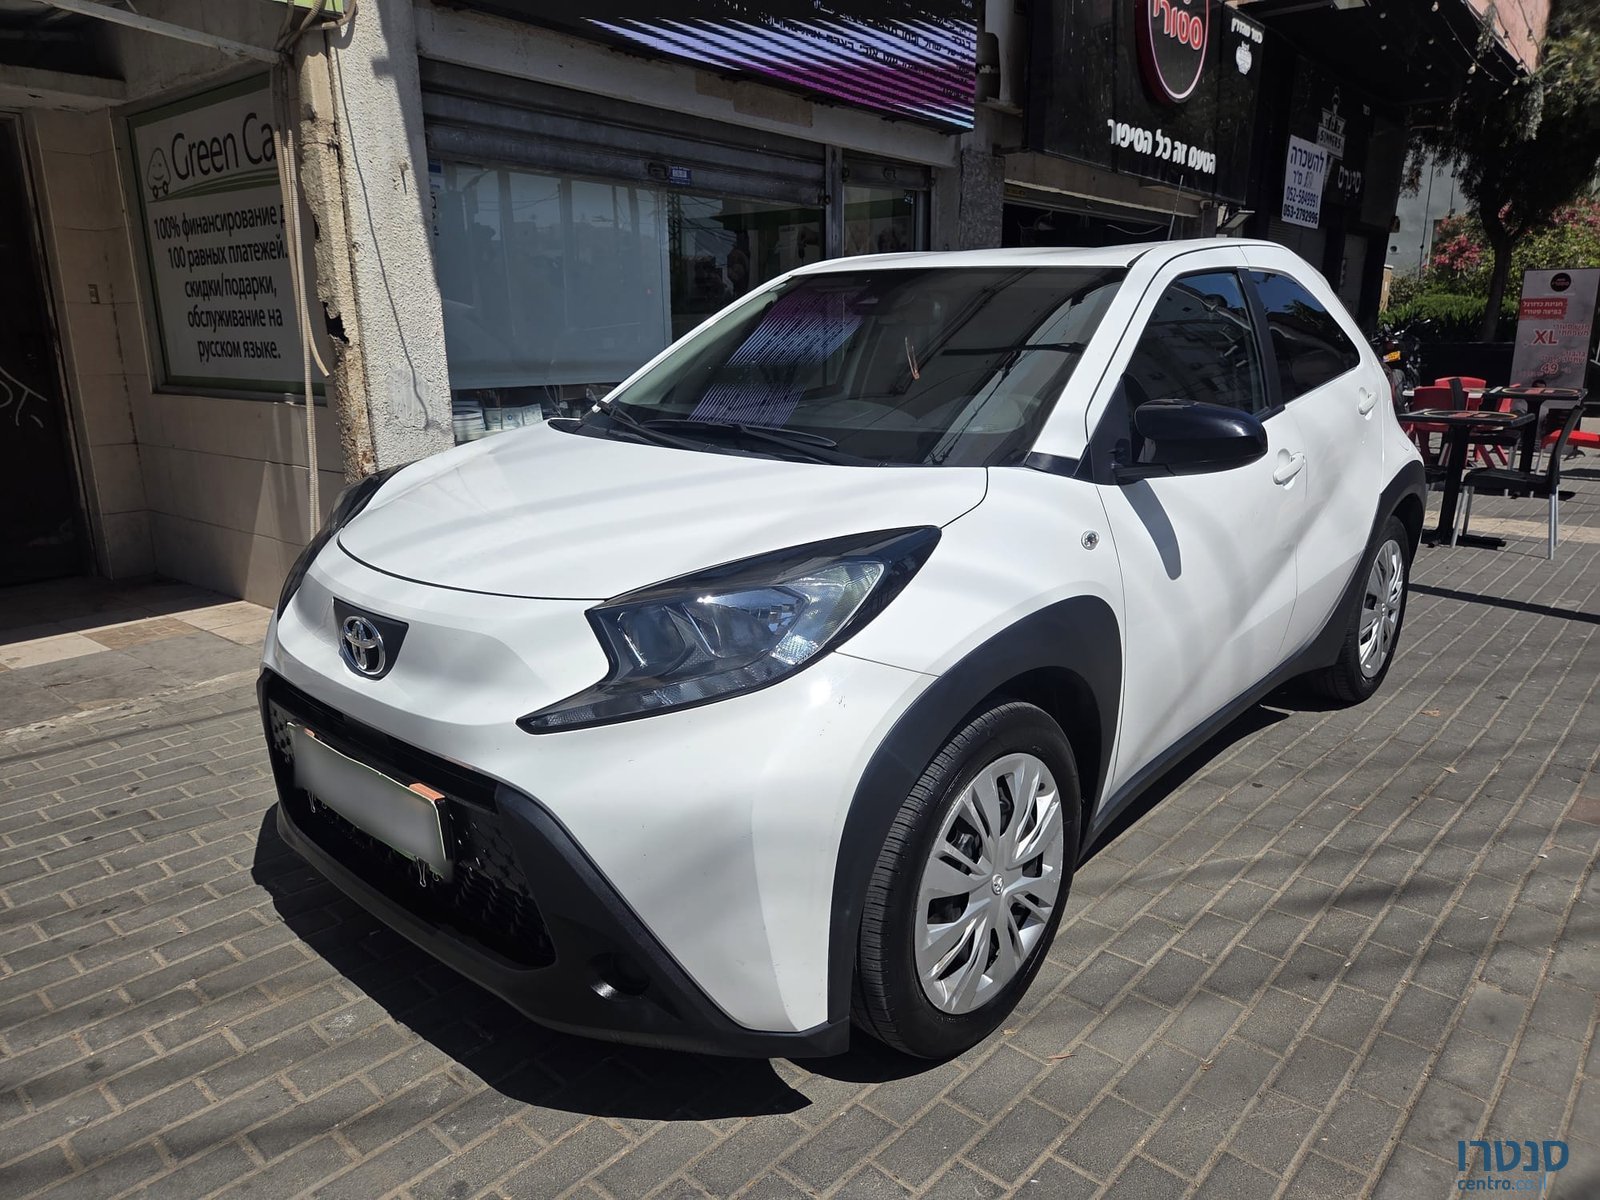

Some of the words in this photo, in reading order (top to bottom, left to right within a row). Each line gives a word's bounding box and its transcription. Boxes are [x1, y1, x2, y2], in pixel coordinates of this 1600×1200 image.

[171, 131, 239, 181] Green
[242, 112, 281, 165] Ca
[1106, 118, 1153, 155] הסיפור
[1154, 128, 1172, 160] כל
[1173, 140, 1187, 165] זה
[1187, 145, 1217, 175] הטעם
[1290, 146, 1325, 174] להשכרה
[153, 213, 181, 240] 100%
[181, 204, 277, 242] финансирование
[167, 245, 187, 270] 100
[186, 244, 228, 273] равных
[228, 233, 288, 264] платежей.
[184, 272, 277, 301] скидки/подарки,
[188, 304, 266, 333] обслуживание
[267, 308, 284, 327] на
[198, 340, 242, 363] русском
[243, 341, 282, 360] языке.
[1532, 329, 1559, 345] XL
[1541, 362, 1559, 374] 49
